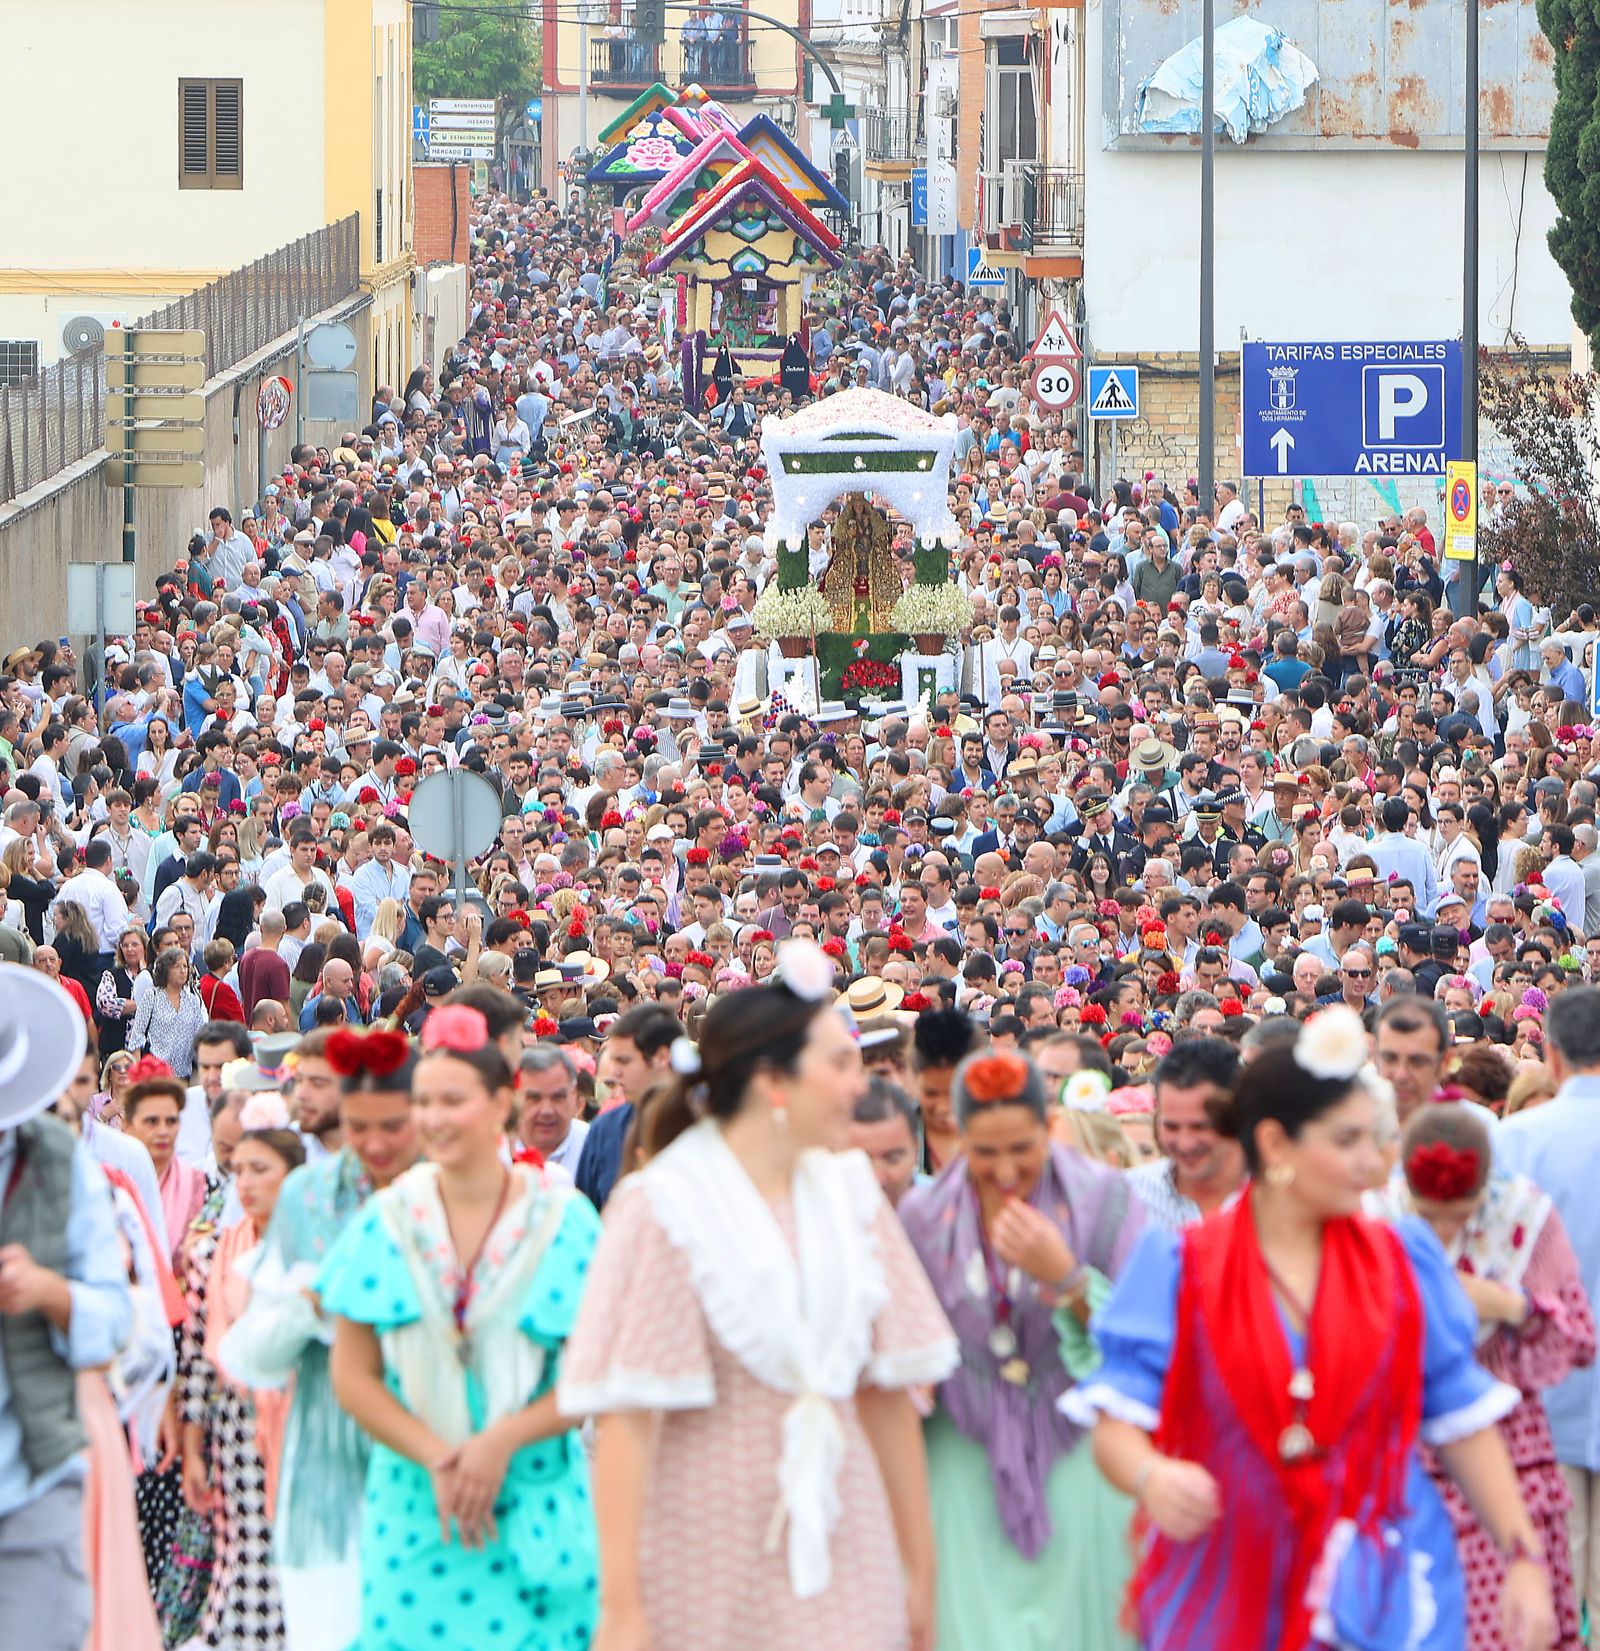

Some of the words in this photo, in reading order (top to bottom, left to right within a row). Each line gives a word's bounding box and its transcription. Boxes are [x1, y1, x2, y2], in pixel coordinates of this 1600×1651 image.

[1266, 346, 1335, 361] TARIFAS
[1341, 344, 1446, 360] ESPECIALES
[1041, 377, 1069, 393] 30
[1379, 374, 1428, 439] P
